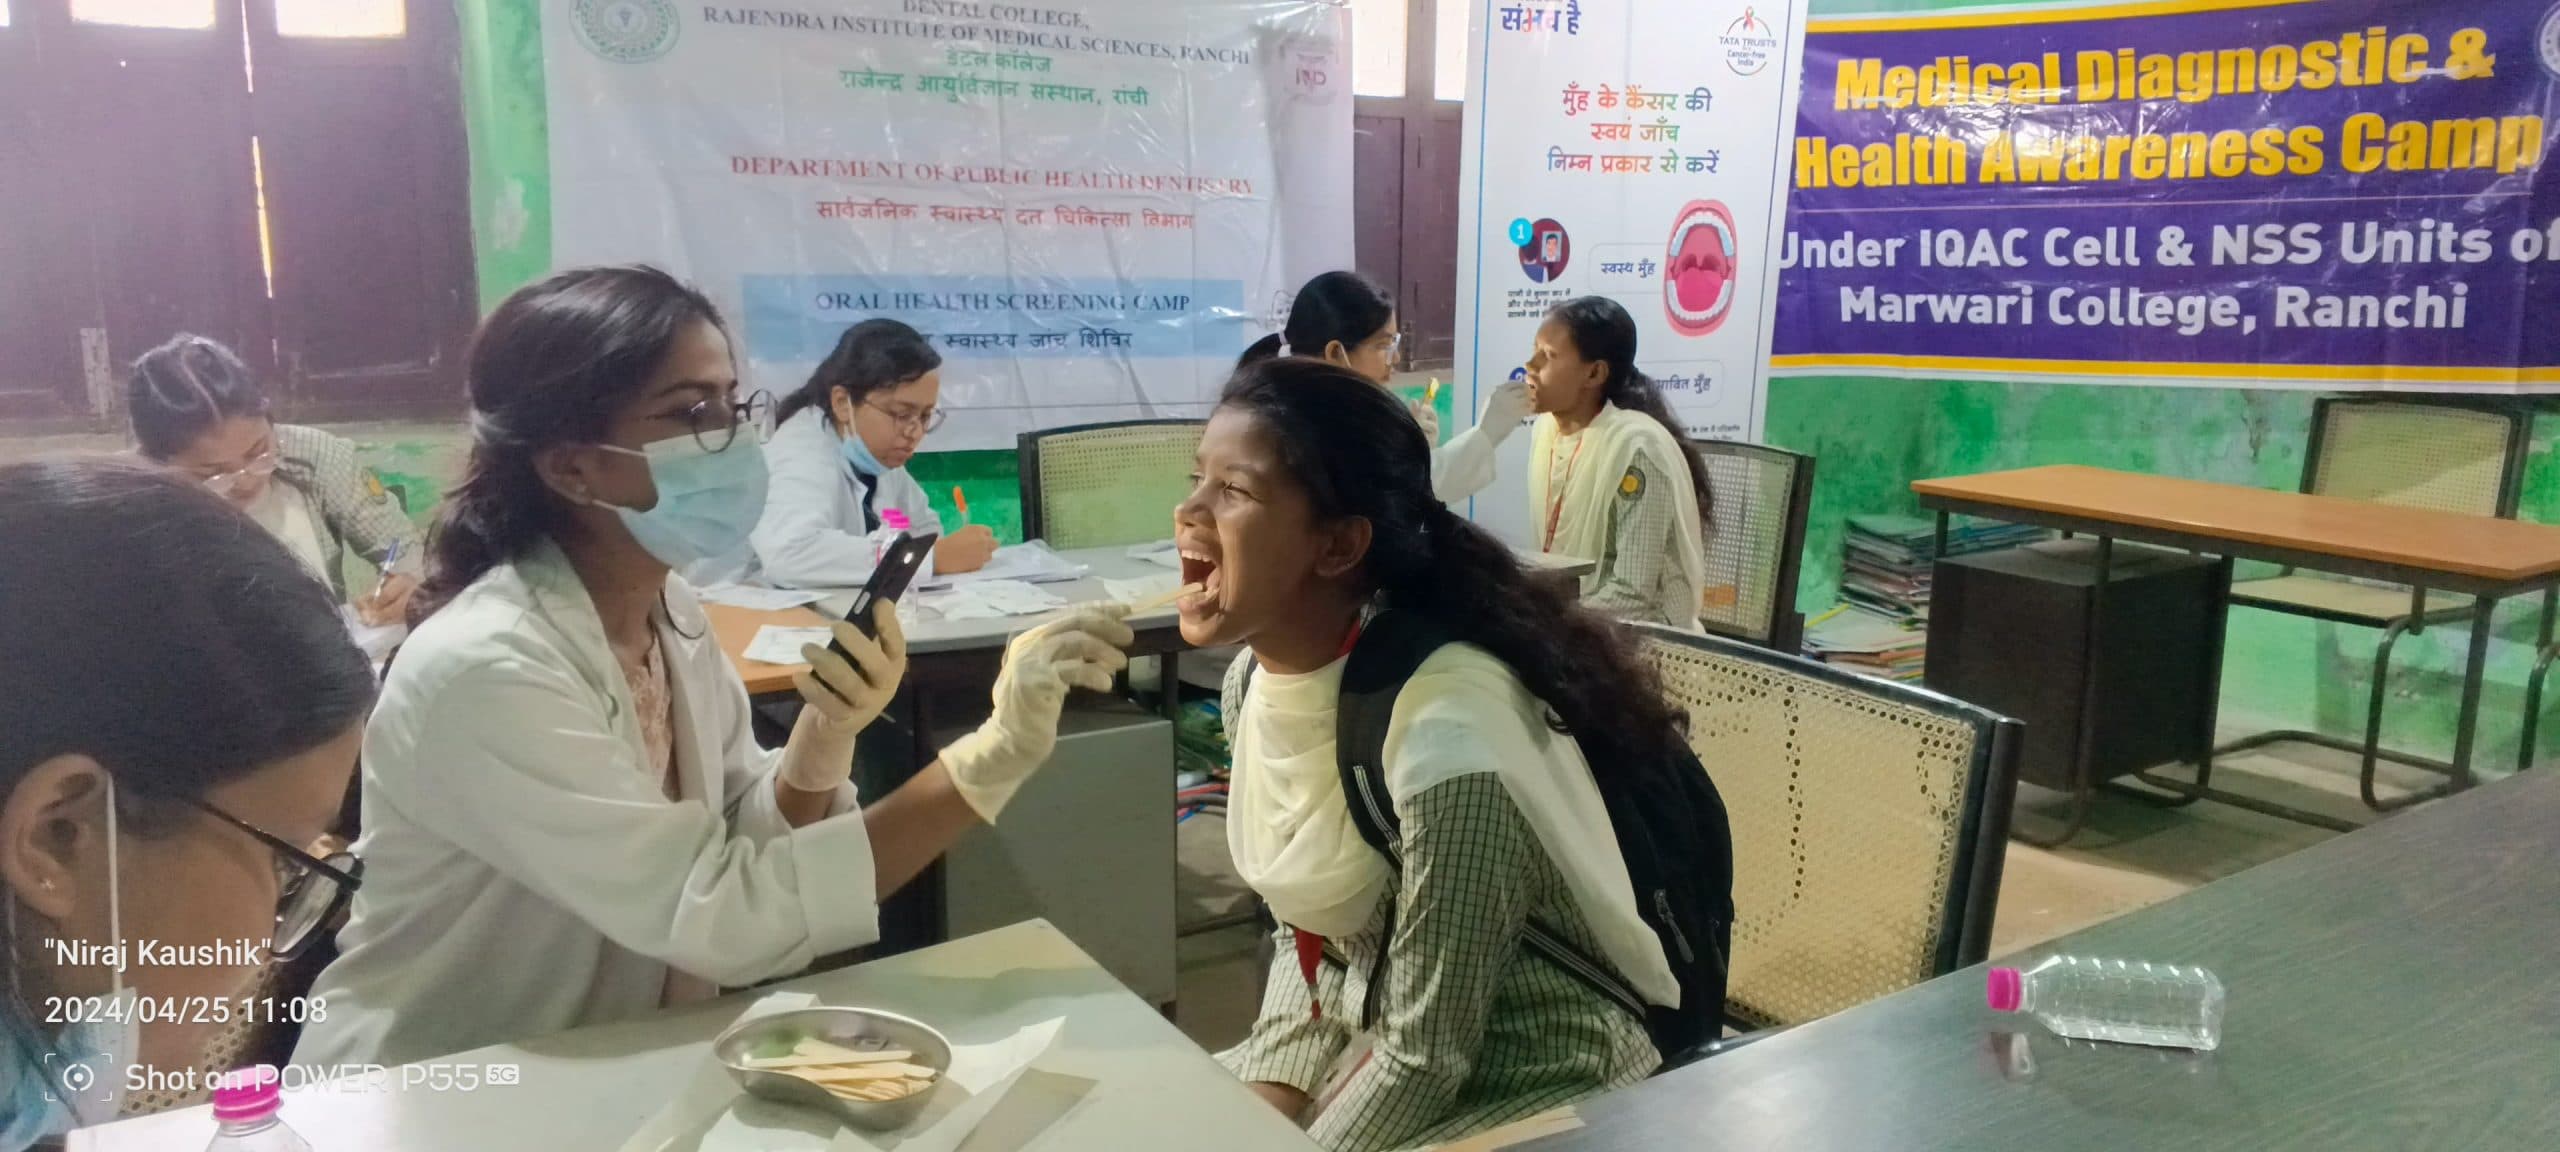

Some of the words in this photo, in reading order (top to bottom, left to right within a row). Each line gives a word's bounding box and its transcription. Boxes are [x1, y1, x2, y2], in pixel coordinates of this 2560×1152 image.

[902, 0, 985, 19] DENTAL
[989, 5, 1090, 33] COLLEGE,
[703, 7, 824, 30] RAJENDRA
[832, 15, 945, 39] INSTITUTE
[951, 25, 978, 42] OF
[983, 28, 1076, 51] MEDICAL
[1080, 37, 1176, 62] SCIENCES,
[1179, 44, 1250, 65] RANCHI
[1719, 36, 1740, 46] TATA
[1742, 38, 1777, 48] TRUSTS
[995, 48, 1053, 72] कॉलेज
[1834, 52, 2061, 110] Medical
[2076, 26, 2429, 105] Diagnostic
[2445, 27, 2496, 81] &
[838, 66, 904, 91] राजेन्द्र
[1562, 81, 1590, 117] मुँह
[1597, 83, 1619, 110] के
[1625, 84, 1679, 111] कैंसर
[1685, 87, 1712, 112] की
[1591, 116, 1632, 141] स्वयं
[1639, 116, 1680, 143] जाँच
[1547, 145, 1593, 173] निम्न
[1600, 155, 1653, 174] प्रकार
[1659, 148, 1680, 174] से
[1685, 149, 1720, 174] करें
[1795, 132, 1967, 188] Health
[1978, 125, 2325, 183] Awareness
[2341, 111, 2544, 174] Camp
[732, 155, 904, 181] DEPARTMENT
[914, 163, 946, 181] OF
[953, 166, 1037, 186] PUBLIC
[1045, 169, 1133, 190] HEALTH
[1517, 223, 1525, 240] 1
[1919, 228, 2029, 268] IQAC
[2043, 226, 2140, 267] Cell
[2156, 225, 2195, 266] &
[2211, 222, 2322, 265] NSS
[2340, 218, 2493, 263] Units
[816, 292, 887, 311] ORAL
[895, 292, 989, 312] HEALTH
[995, 293, 1126, 312] SCREENING
[1133, 294, 1190, 312] CAMP
[1839, 285, 2033, 325] Marwari
[2049, 286, 2256, 336] College,
[2275, 282, 2469, 328] Ranchi
[1079, 327, 1132, 348] शिविर
